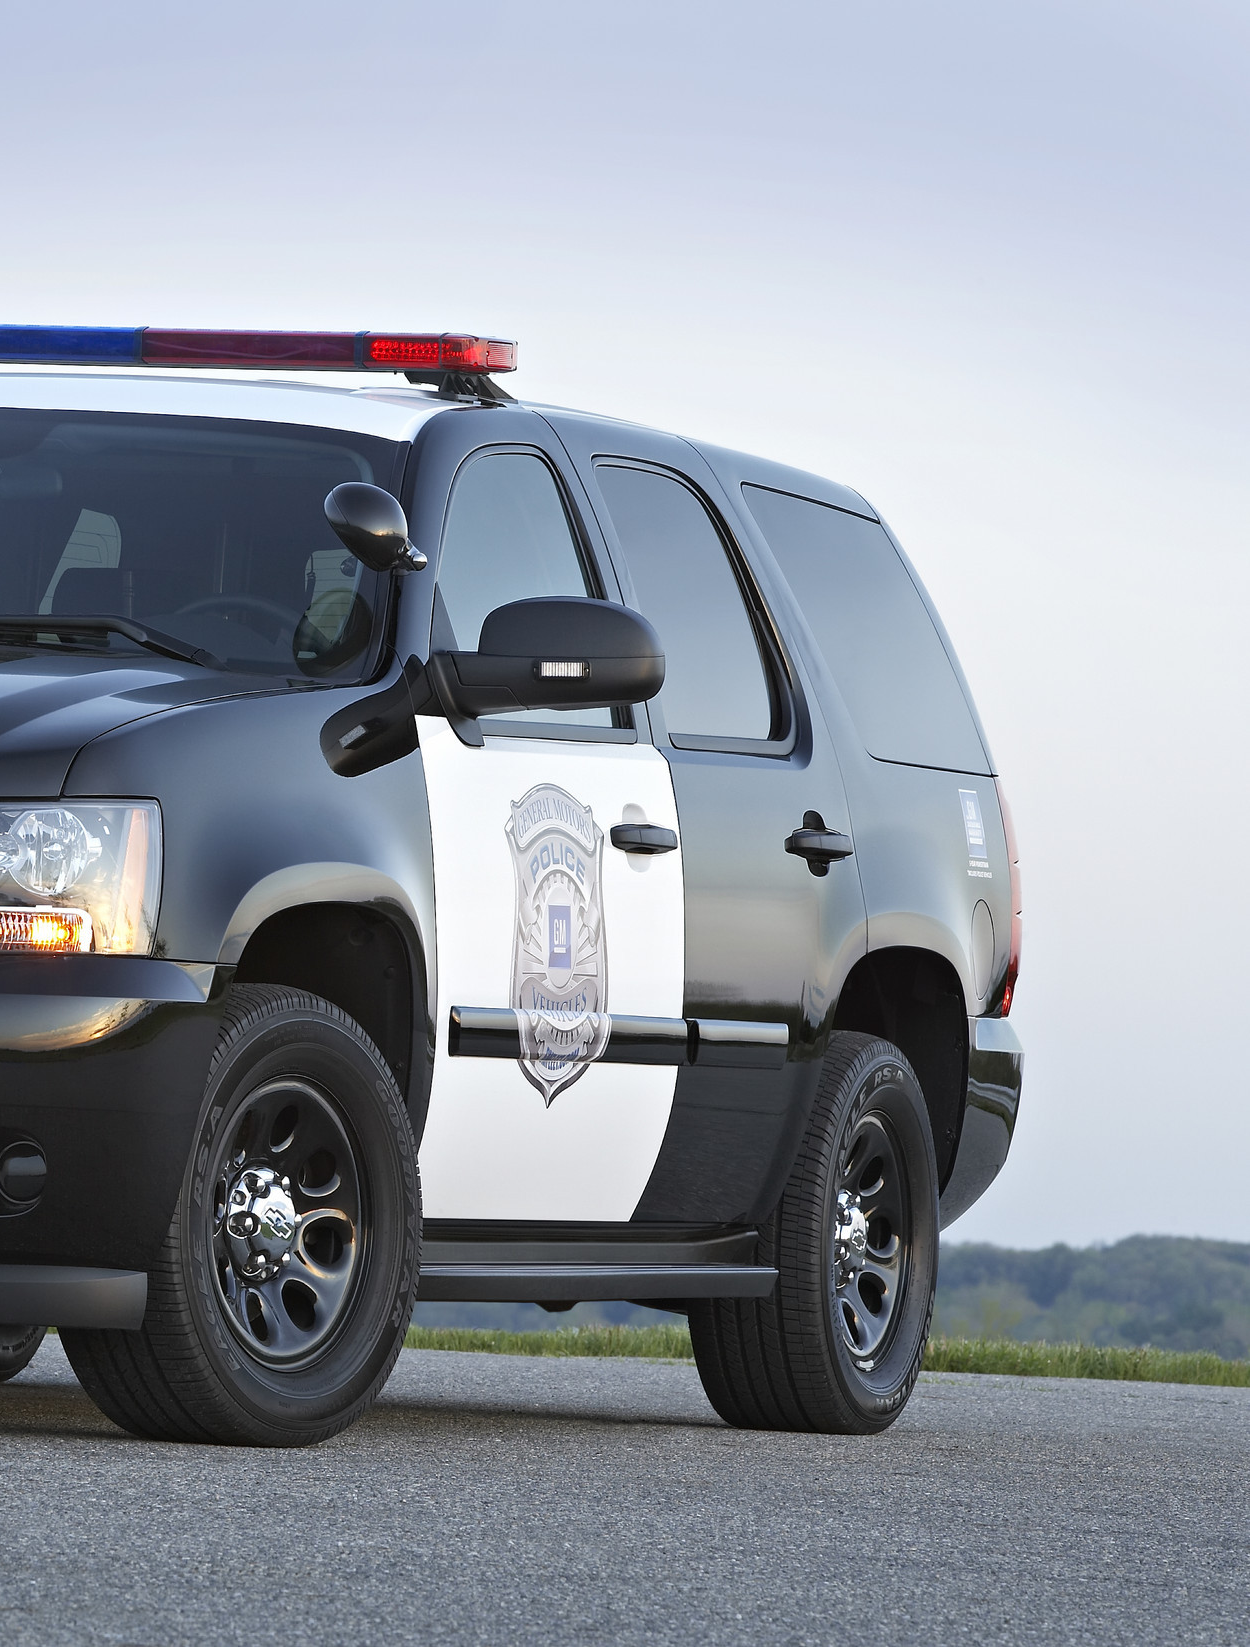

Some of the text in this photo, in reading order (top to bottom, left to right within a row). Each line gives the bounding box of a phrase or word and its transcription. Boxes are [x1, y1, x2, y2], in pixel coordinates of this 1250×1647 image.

[517, 797, 591, 843] GENERAL MOTORS
[530, 842, 586, 886] POLICE
[553, 918, 567, 946] GM
[532, 987, 587, 1022] VEHICLES
[375, 1080, 416, 1328] GOODYEAR
[193, 1233, 241, 1372] EAGLE
